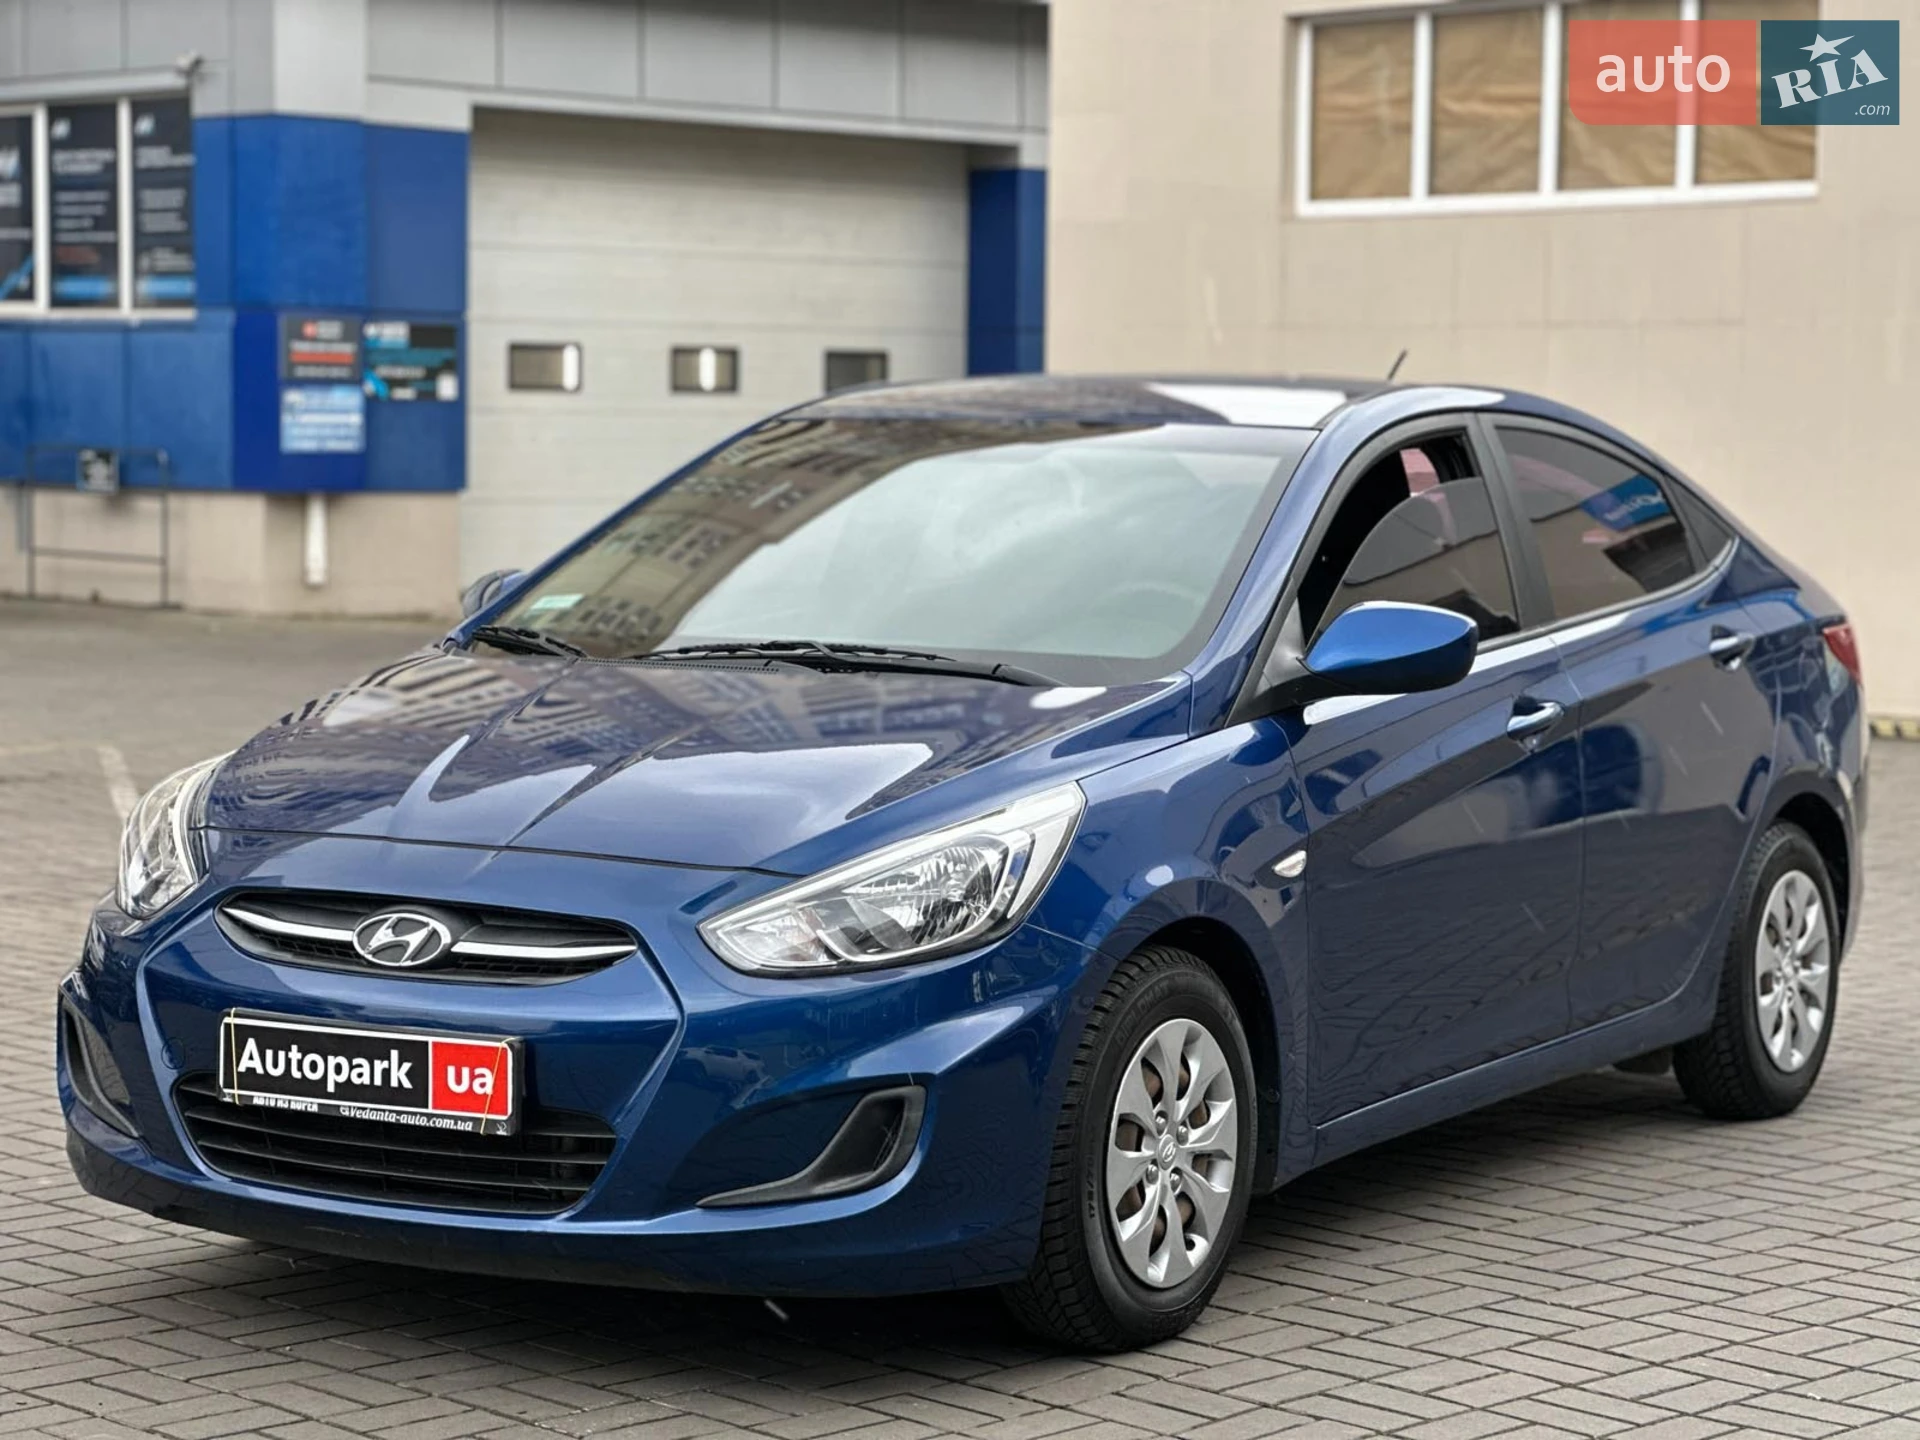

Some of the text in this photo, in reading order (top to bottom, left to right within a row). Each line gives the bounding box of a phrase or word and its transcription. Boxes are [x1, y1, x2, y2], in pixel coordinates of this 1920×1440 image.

[237, 1037, 494, 1095] Autopark ua
[349, 1104, 474, 1131] Vedanta-auto.com.ua
